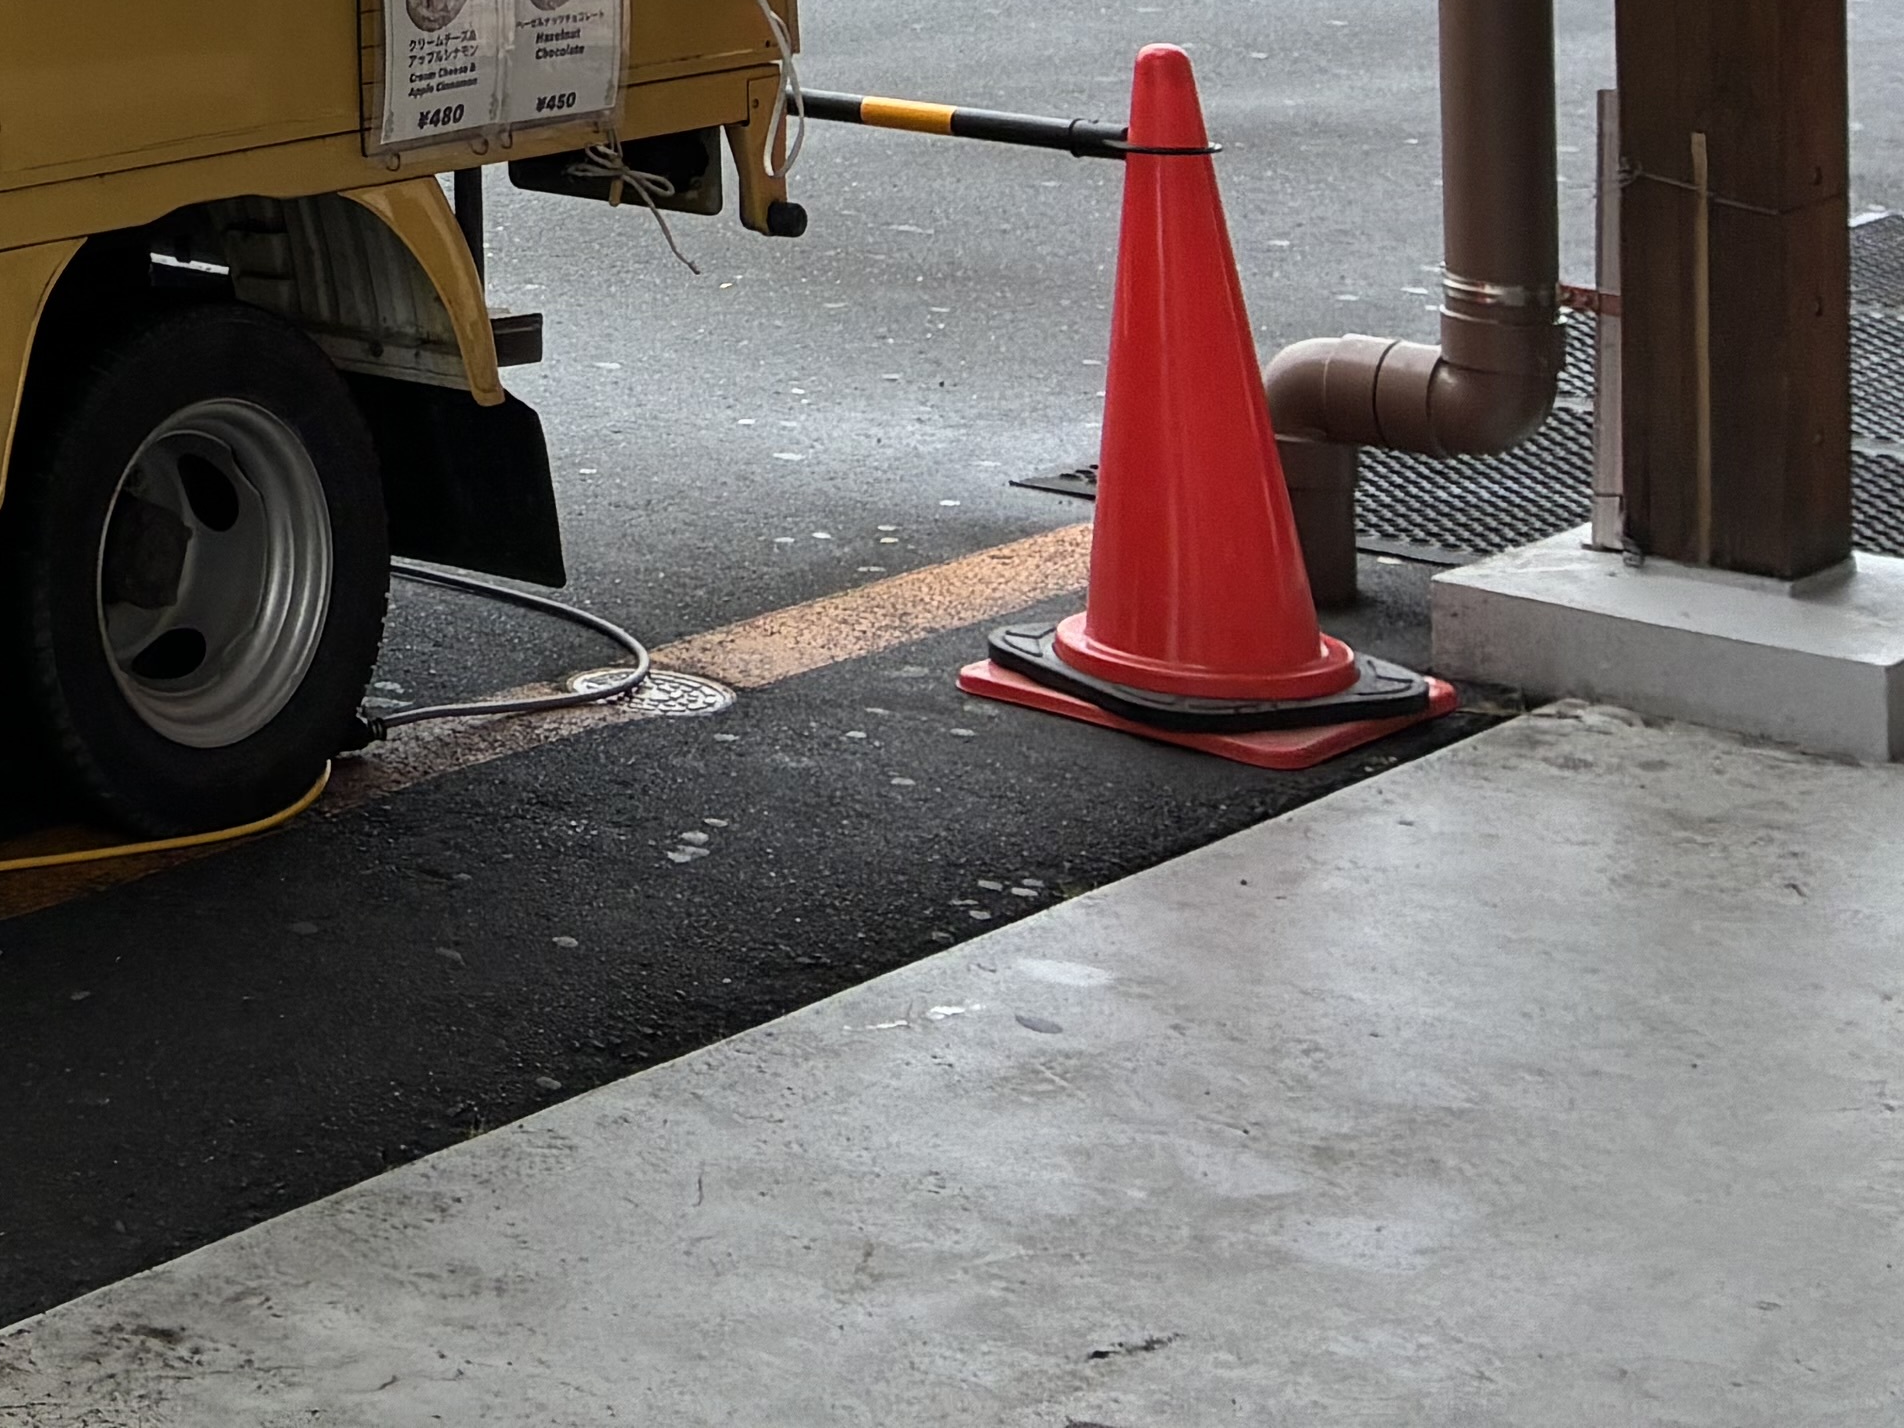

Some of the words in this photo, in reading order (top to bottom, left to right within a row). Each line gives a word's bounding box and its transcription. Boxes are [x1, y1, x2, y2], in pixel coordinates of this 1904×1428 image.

[408, 44, 479, 68] アップルシナモン
[535, 92, 576, 112] ¥450
[418, 103, 465, 129] ¥480
